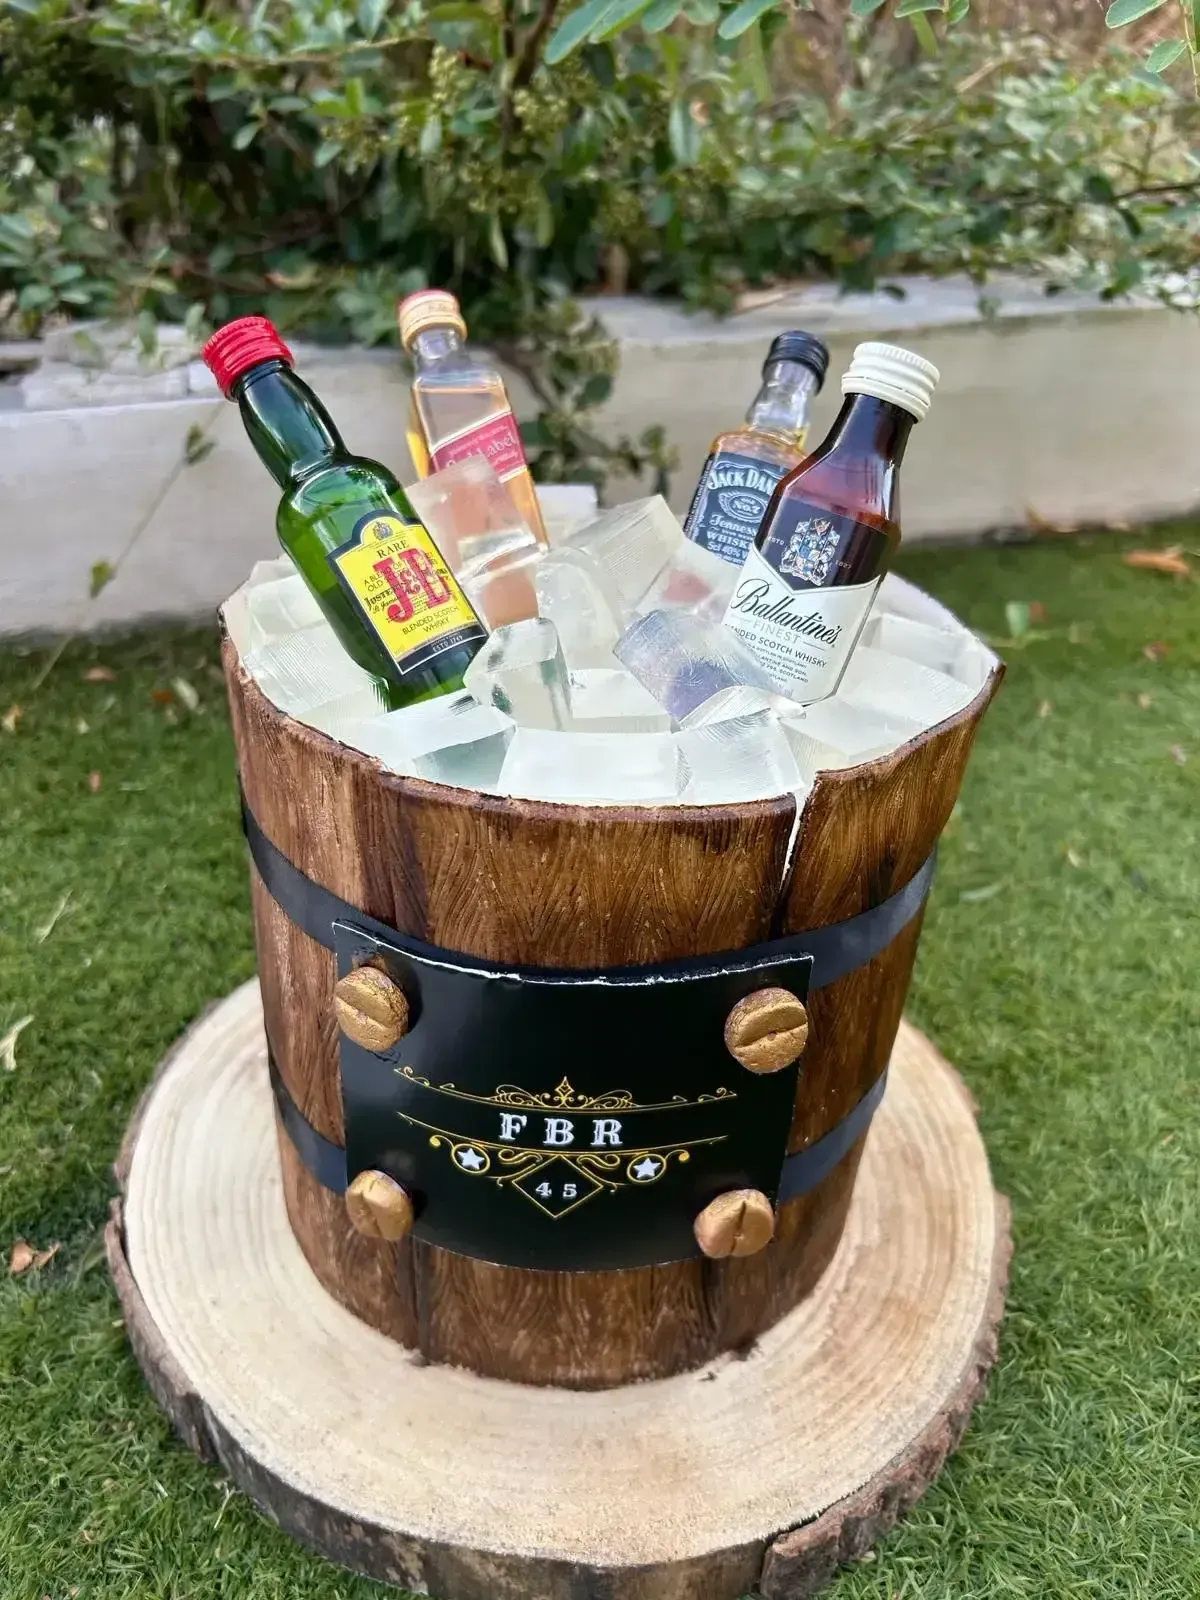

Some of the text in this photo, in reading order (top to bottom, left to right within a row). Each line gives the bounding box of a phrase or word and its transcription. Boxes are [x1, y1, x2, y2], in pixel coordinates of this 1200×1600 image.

[708, 468, 777, 496] JACK DAN
[376, 539, 410, 559] RARE
[707, 530, 750, 549] WHISK
[372, 547, 453, 624] J&B
[402, 606, 460, 635] BLENDED SCOTCH
[422, 616, 450, 632] WHISKY
[730, 577, 843, 645] Ballantine's
[752, 621, 801, 645] FINEST
[757, 636, 793, 655] SCOTCH
[794, 650, 828, 668] WHISKY
